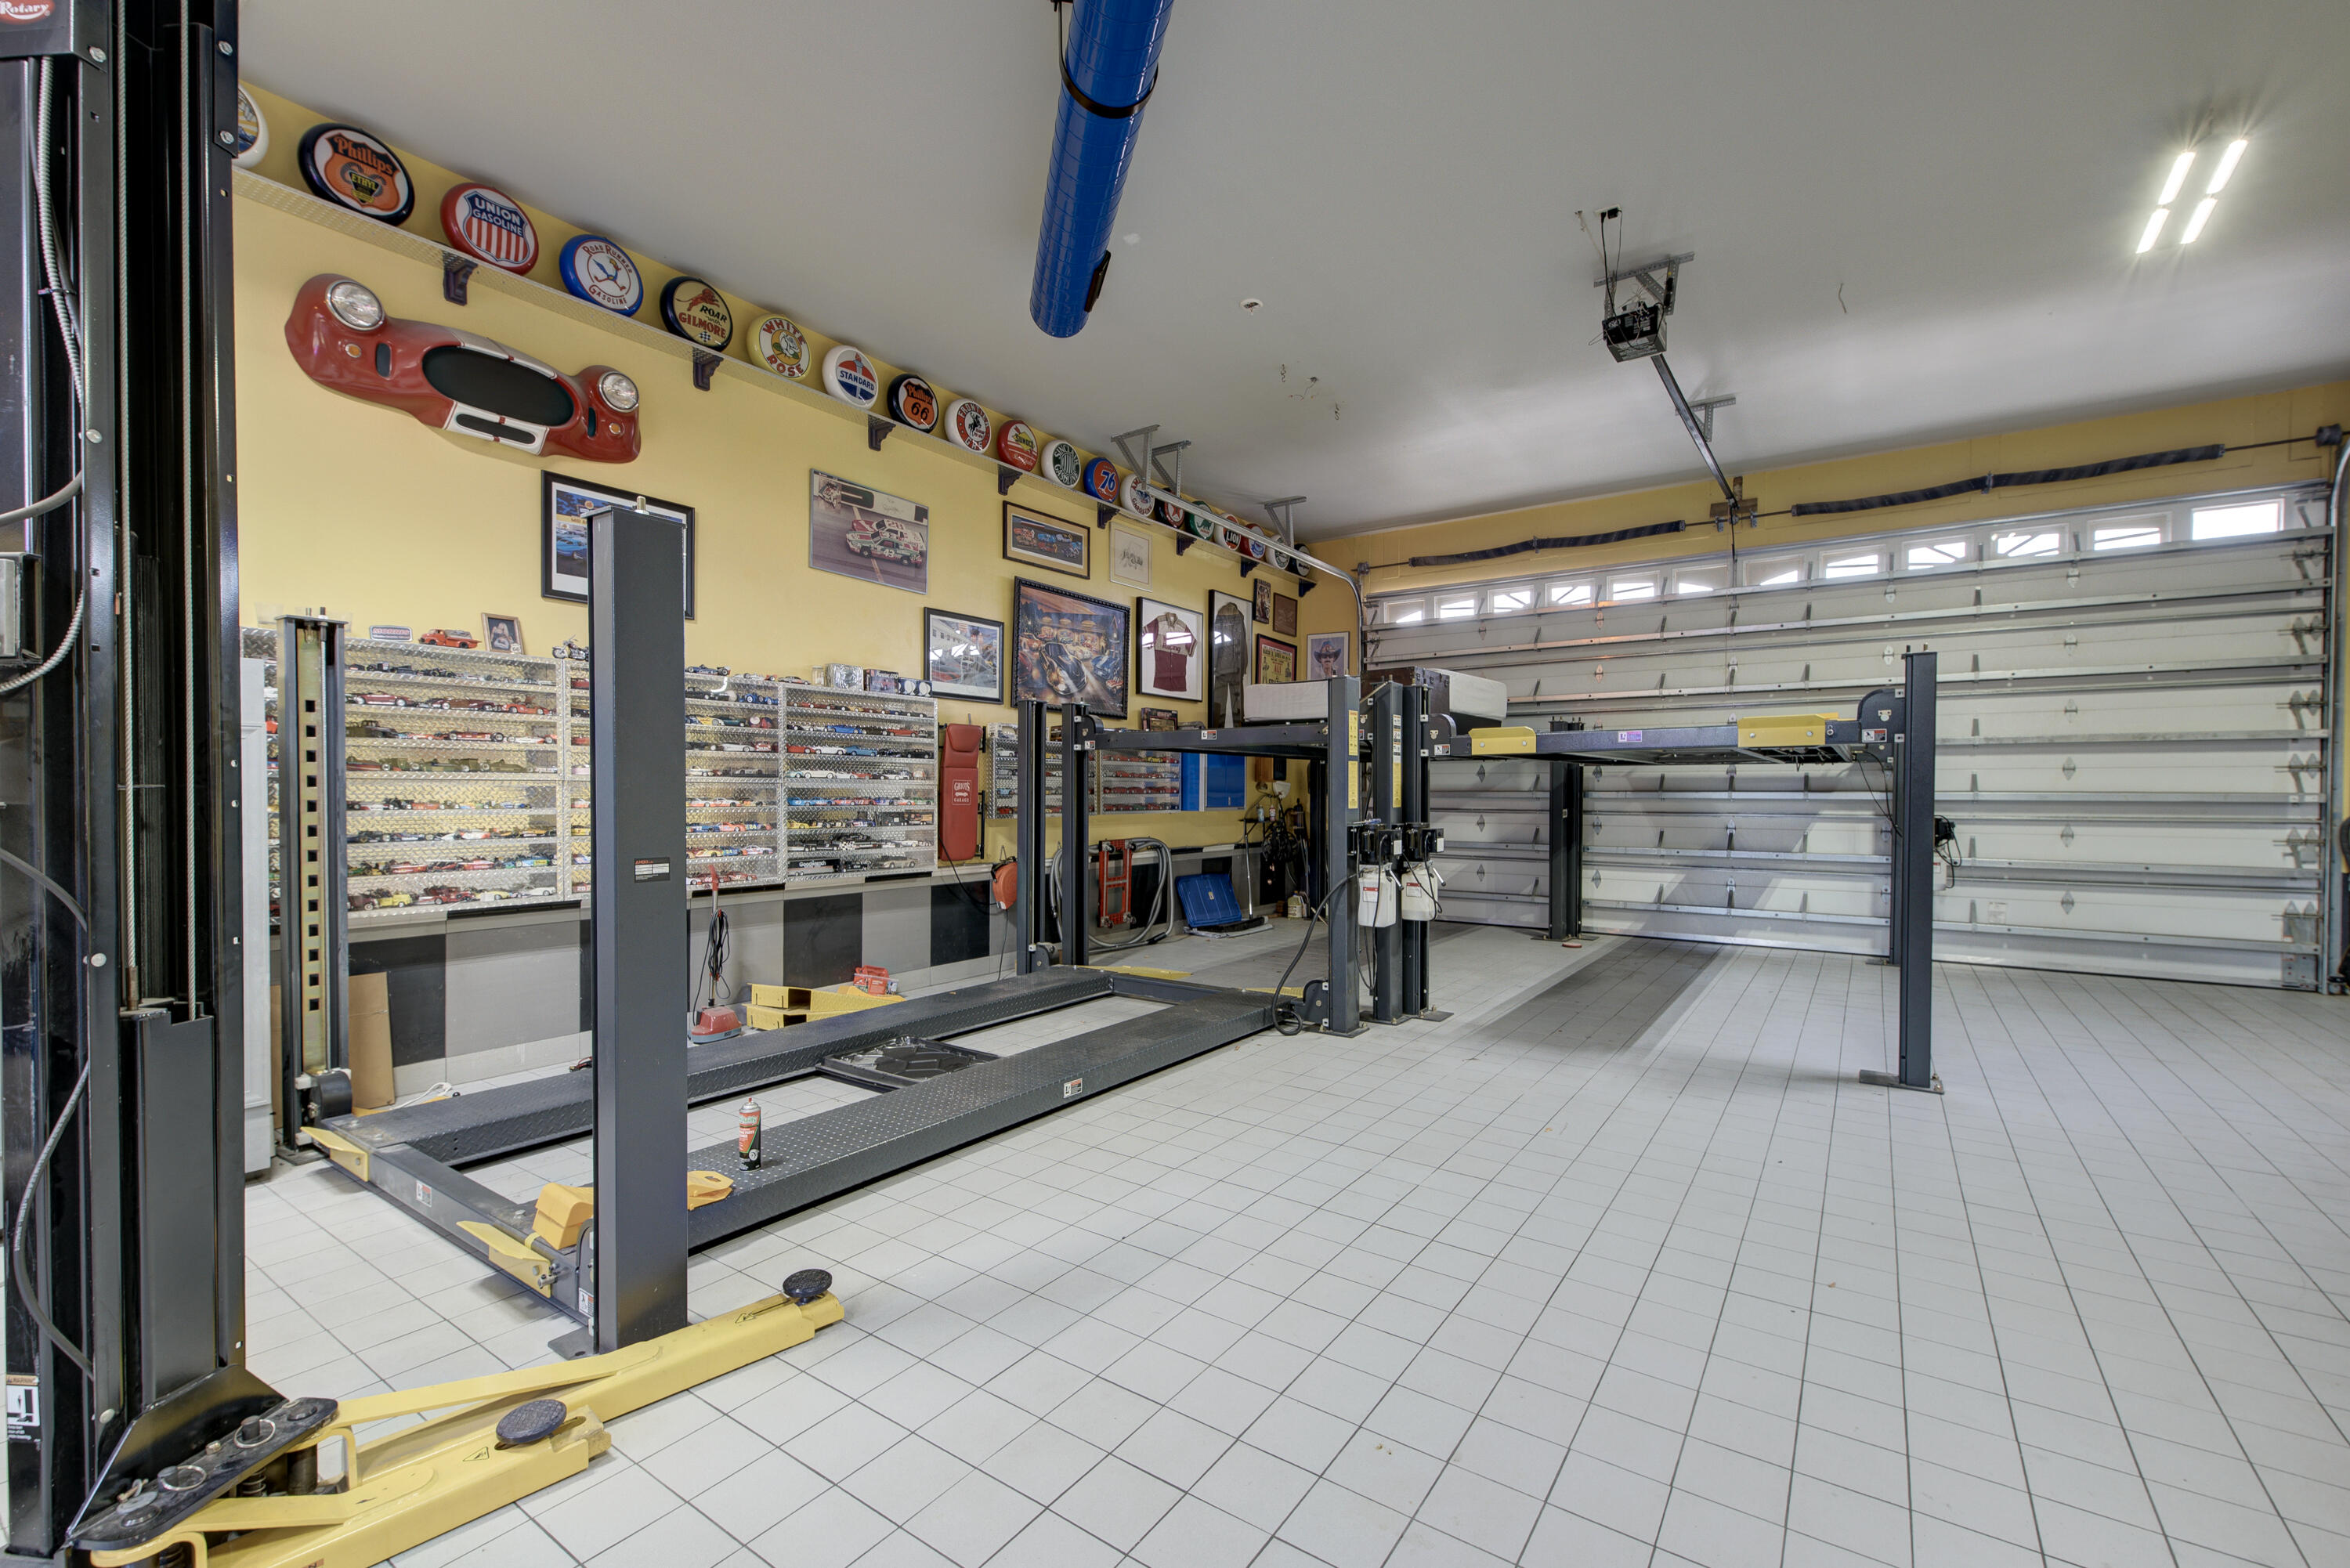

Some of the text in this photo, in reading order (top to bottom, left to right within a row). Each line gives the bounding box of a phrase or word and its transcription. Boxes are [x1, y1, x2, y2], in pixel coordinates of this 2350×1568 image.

[0, 1, 49, 16] Rotary
[333, 136, 393, 173] Phillips
[351, 172, 377, 190] ETHYL
[474, 197, 521, 226] UNION
[472, 208, 523, 237] GASOLINE
[582, 244, 633, 274] ROAD RUNNER
[588, 284, 627, 305] GASOLINE
[700, 305, 728, 324] ROAR
[678, 312, 726, 339] GILMORE
[762, 319, 806, 345] WHITE
[766, 354, 804, 377] ROSE
[840, 370, 875, 391] STANDARD
[906, 385, 933, 405] Phillips
[911, 402, 930, 421] 66
[1014, 432, 1034, 448] SUNOCO
[1054, 443, 1079, 465] SINCLAIR
[1054, 463, 1079, 485] GASOLINE
[1098, 469, 1117, 493] 76
[1226, 530, 1239, 544] LION
[883, 548, 895, 558] 43
